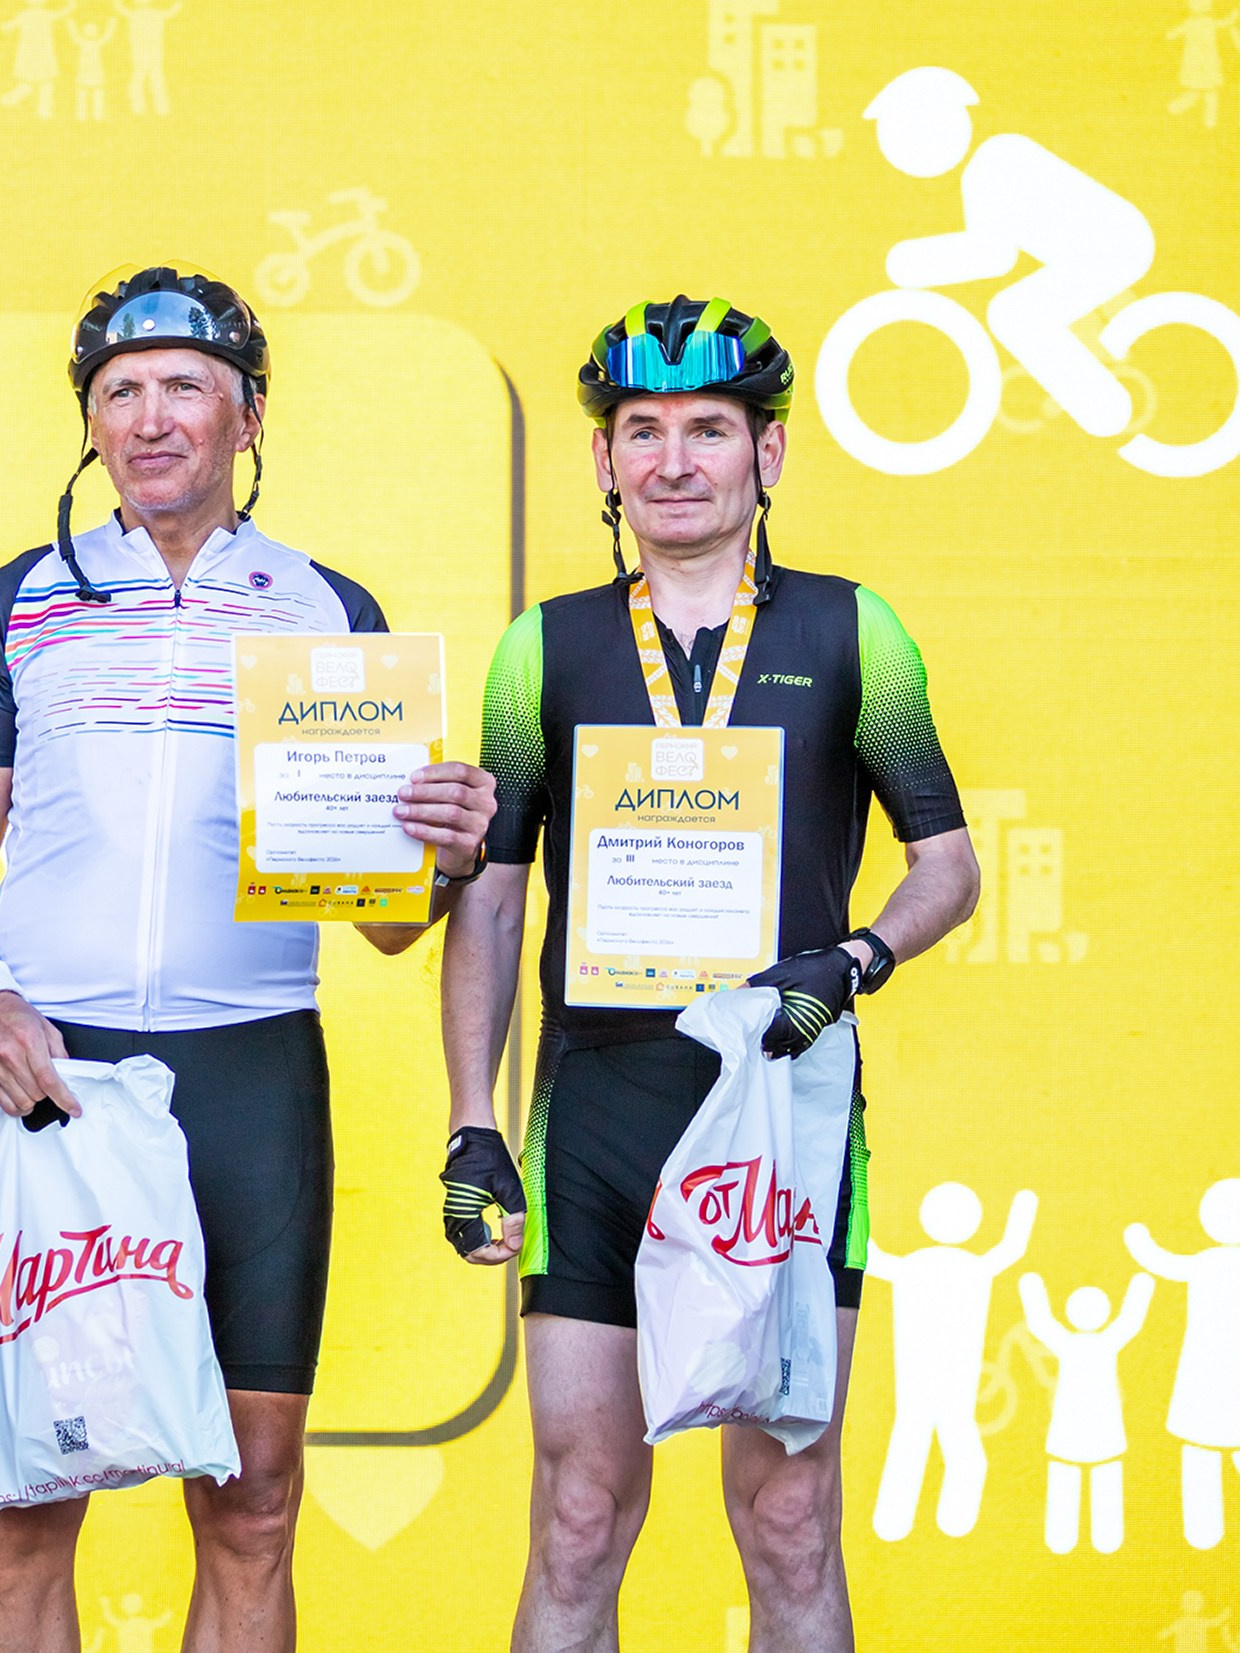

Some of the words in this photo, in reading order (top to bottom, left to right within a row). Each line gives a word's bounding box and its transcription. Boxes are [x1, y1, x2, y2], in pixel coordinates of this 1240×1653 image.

[756, 673, 814, 689] X-TIGER
[278, 700, 403, 725] ДИПЛОМ
[301, 728, 381, 736] награждается
[287, 750, 331, 764] Игорь
[334, 750, 386, 765] Петров
[274, 790, 361, 803] Любительский
[364, 793, 399, 804] заезд
[615, 788, 740, 811] ДИПЛОМ
[637, 815, 716, 823] награждается
[596, 835, 663, 850] Дмитрий
[666, 837, 746, 852] Коногоров
[606, 875, 695, 888] Любительский
[697, 879, 734, 889] заезд
